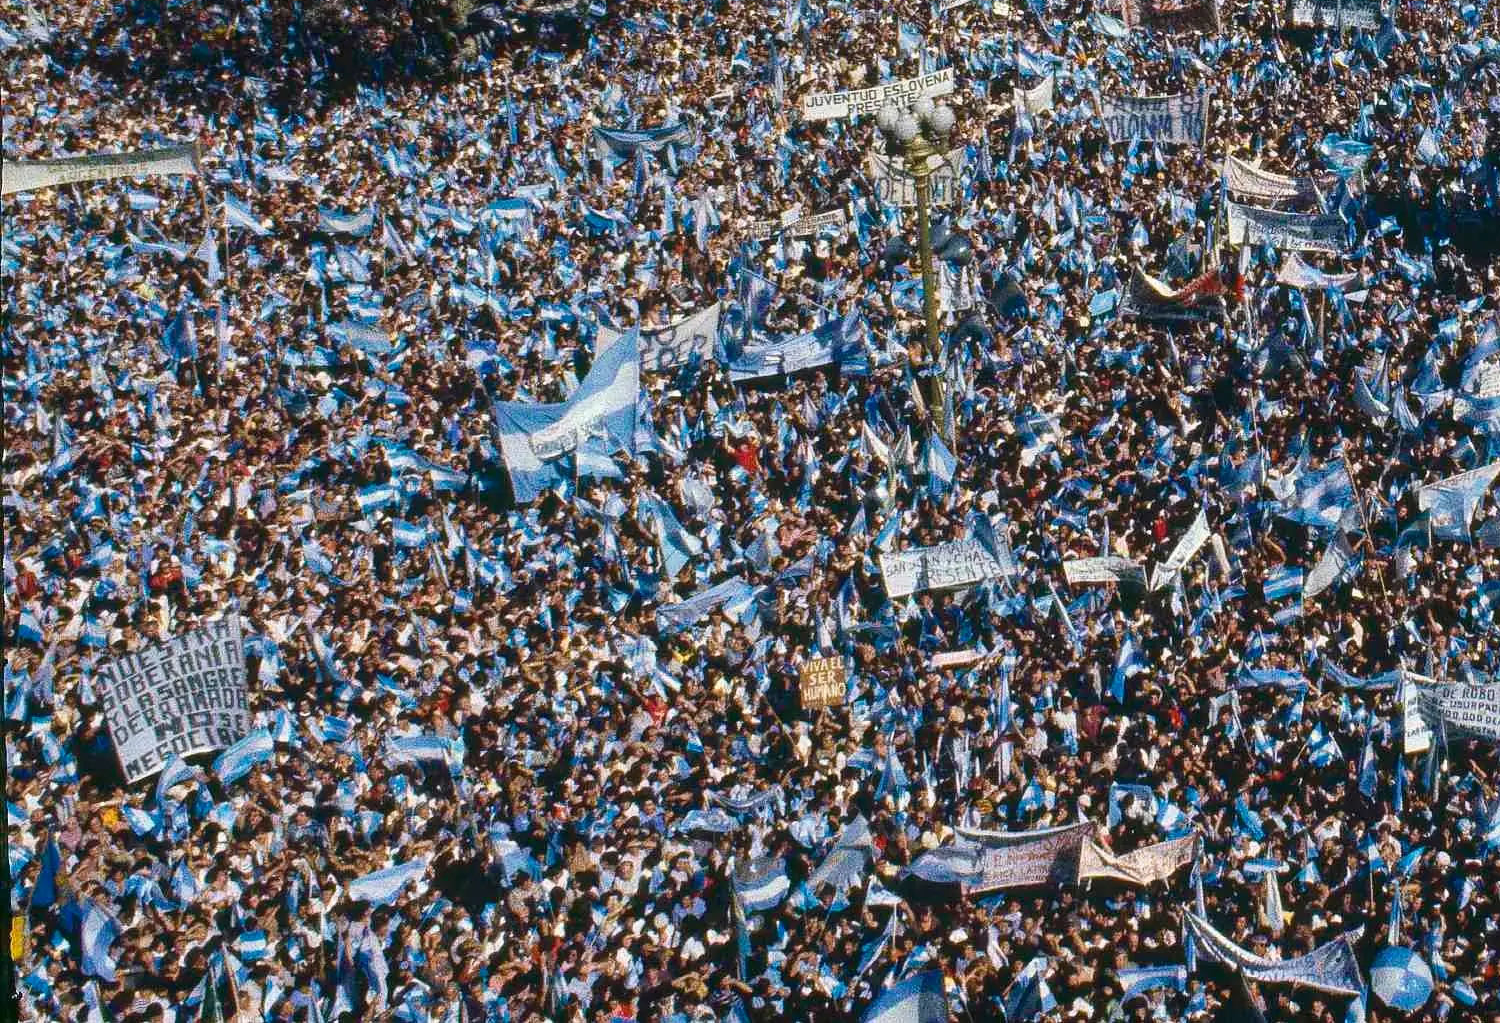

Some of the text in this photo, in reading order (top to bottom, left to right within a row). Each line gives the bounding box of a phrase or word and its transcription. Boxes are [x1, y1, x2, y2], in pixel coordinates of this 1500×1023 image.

[806, 71, 951, 109] JUVENTUD ESLOVENA
[801, 655, 845, 673] VIVA EL
[809, 670, 837, 686] SER
[105, 667, 243, 727] Y LA SANGRE
[803, 683, 847, 702] HUMANO
[1442, 688, 1458, 700] DE
[1461, 688, 1496, 702] ROBO
[114, 688, 251, 747] DERRAMADA
[155, 710, 246, 742] NO SE
